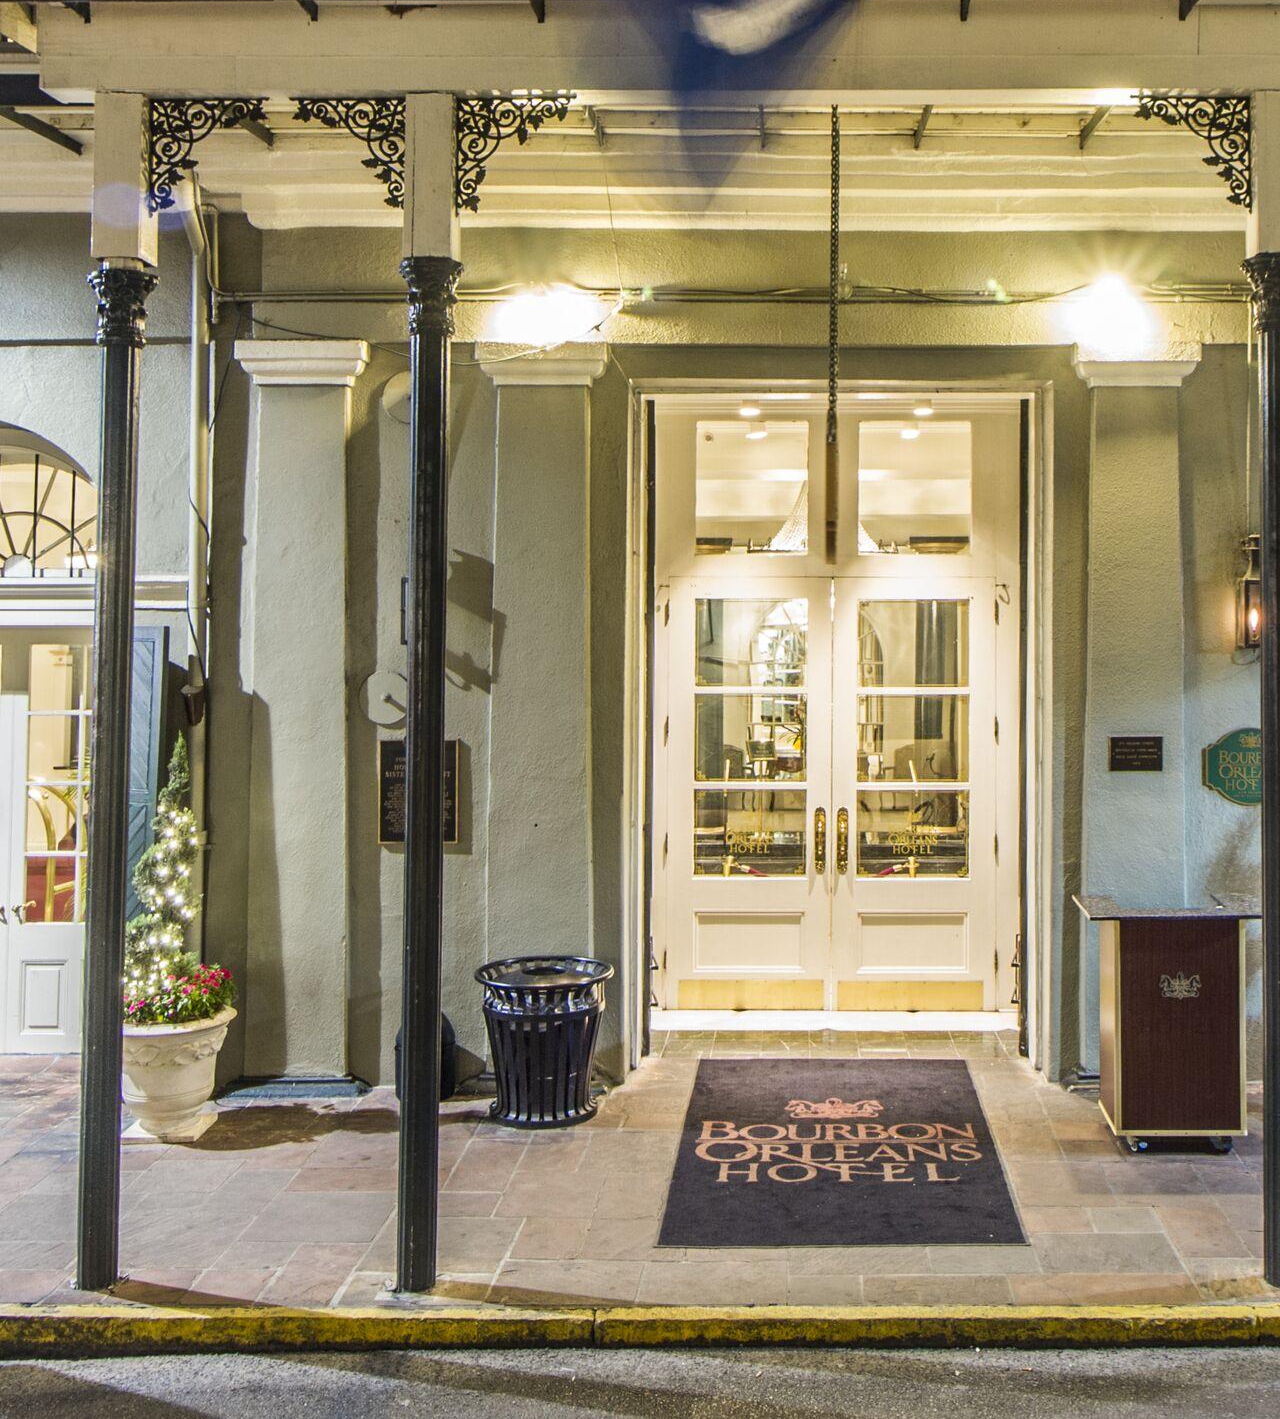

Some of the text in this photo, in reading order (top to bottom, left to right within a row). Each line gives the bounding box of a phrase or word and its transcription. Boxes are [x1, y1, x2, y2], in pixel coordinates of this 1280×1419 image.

[1219, 750, 1261, 764] BOURB
[1218, 764, 1261, 779] ORLE
[729, 844, 770, 854] HOTEL
[892, 844, 934, 855] HOTEL
[699, 1120, 975, 1141] BOURBON
[694, 1142, 983, 1163] ORLEANS
[715, 1162, 961, 1182] HOTEL
